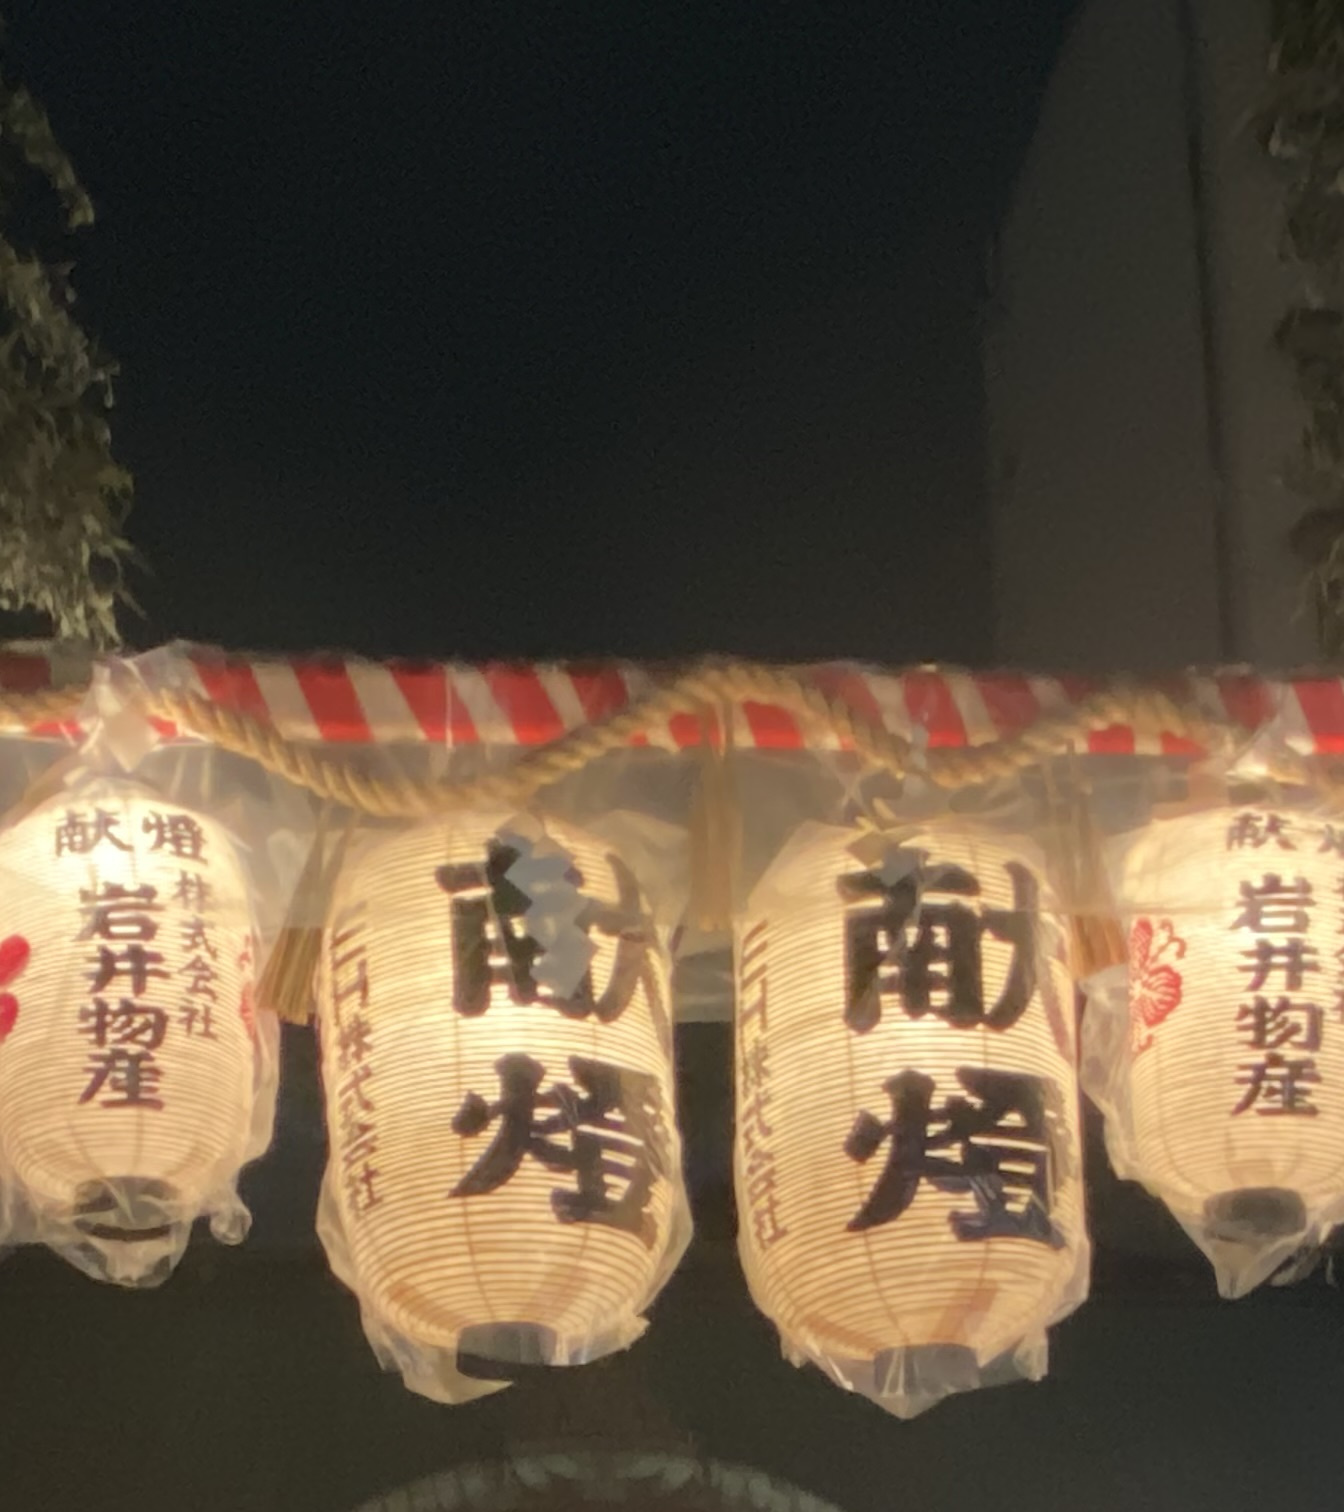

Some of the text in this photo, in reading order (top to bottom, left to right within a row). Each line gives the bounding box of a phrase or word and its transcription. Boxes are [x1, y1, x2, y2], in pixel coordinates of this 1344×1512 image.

[56, 808, 208, 864] 献燈
[73, 881, 171, 1112] 岩井物産
[174, 868, 218, 1041] 株式会社
[1220, 872, 1325, 1118] 岩井物産
